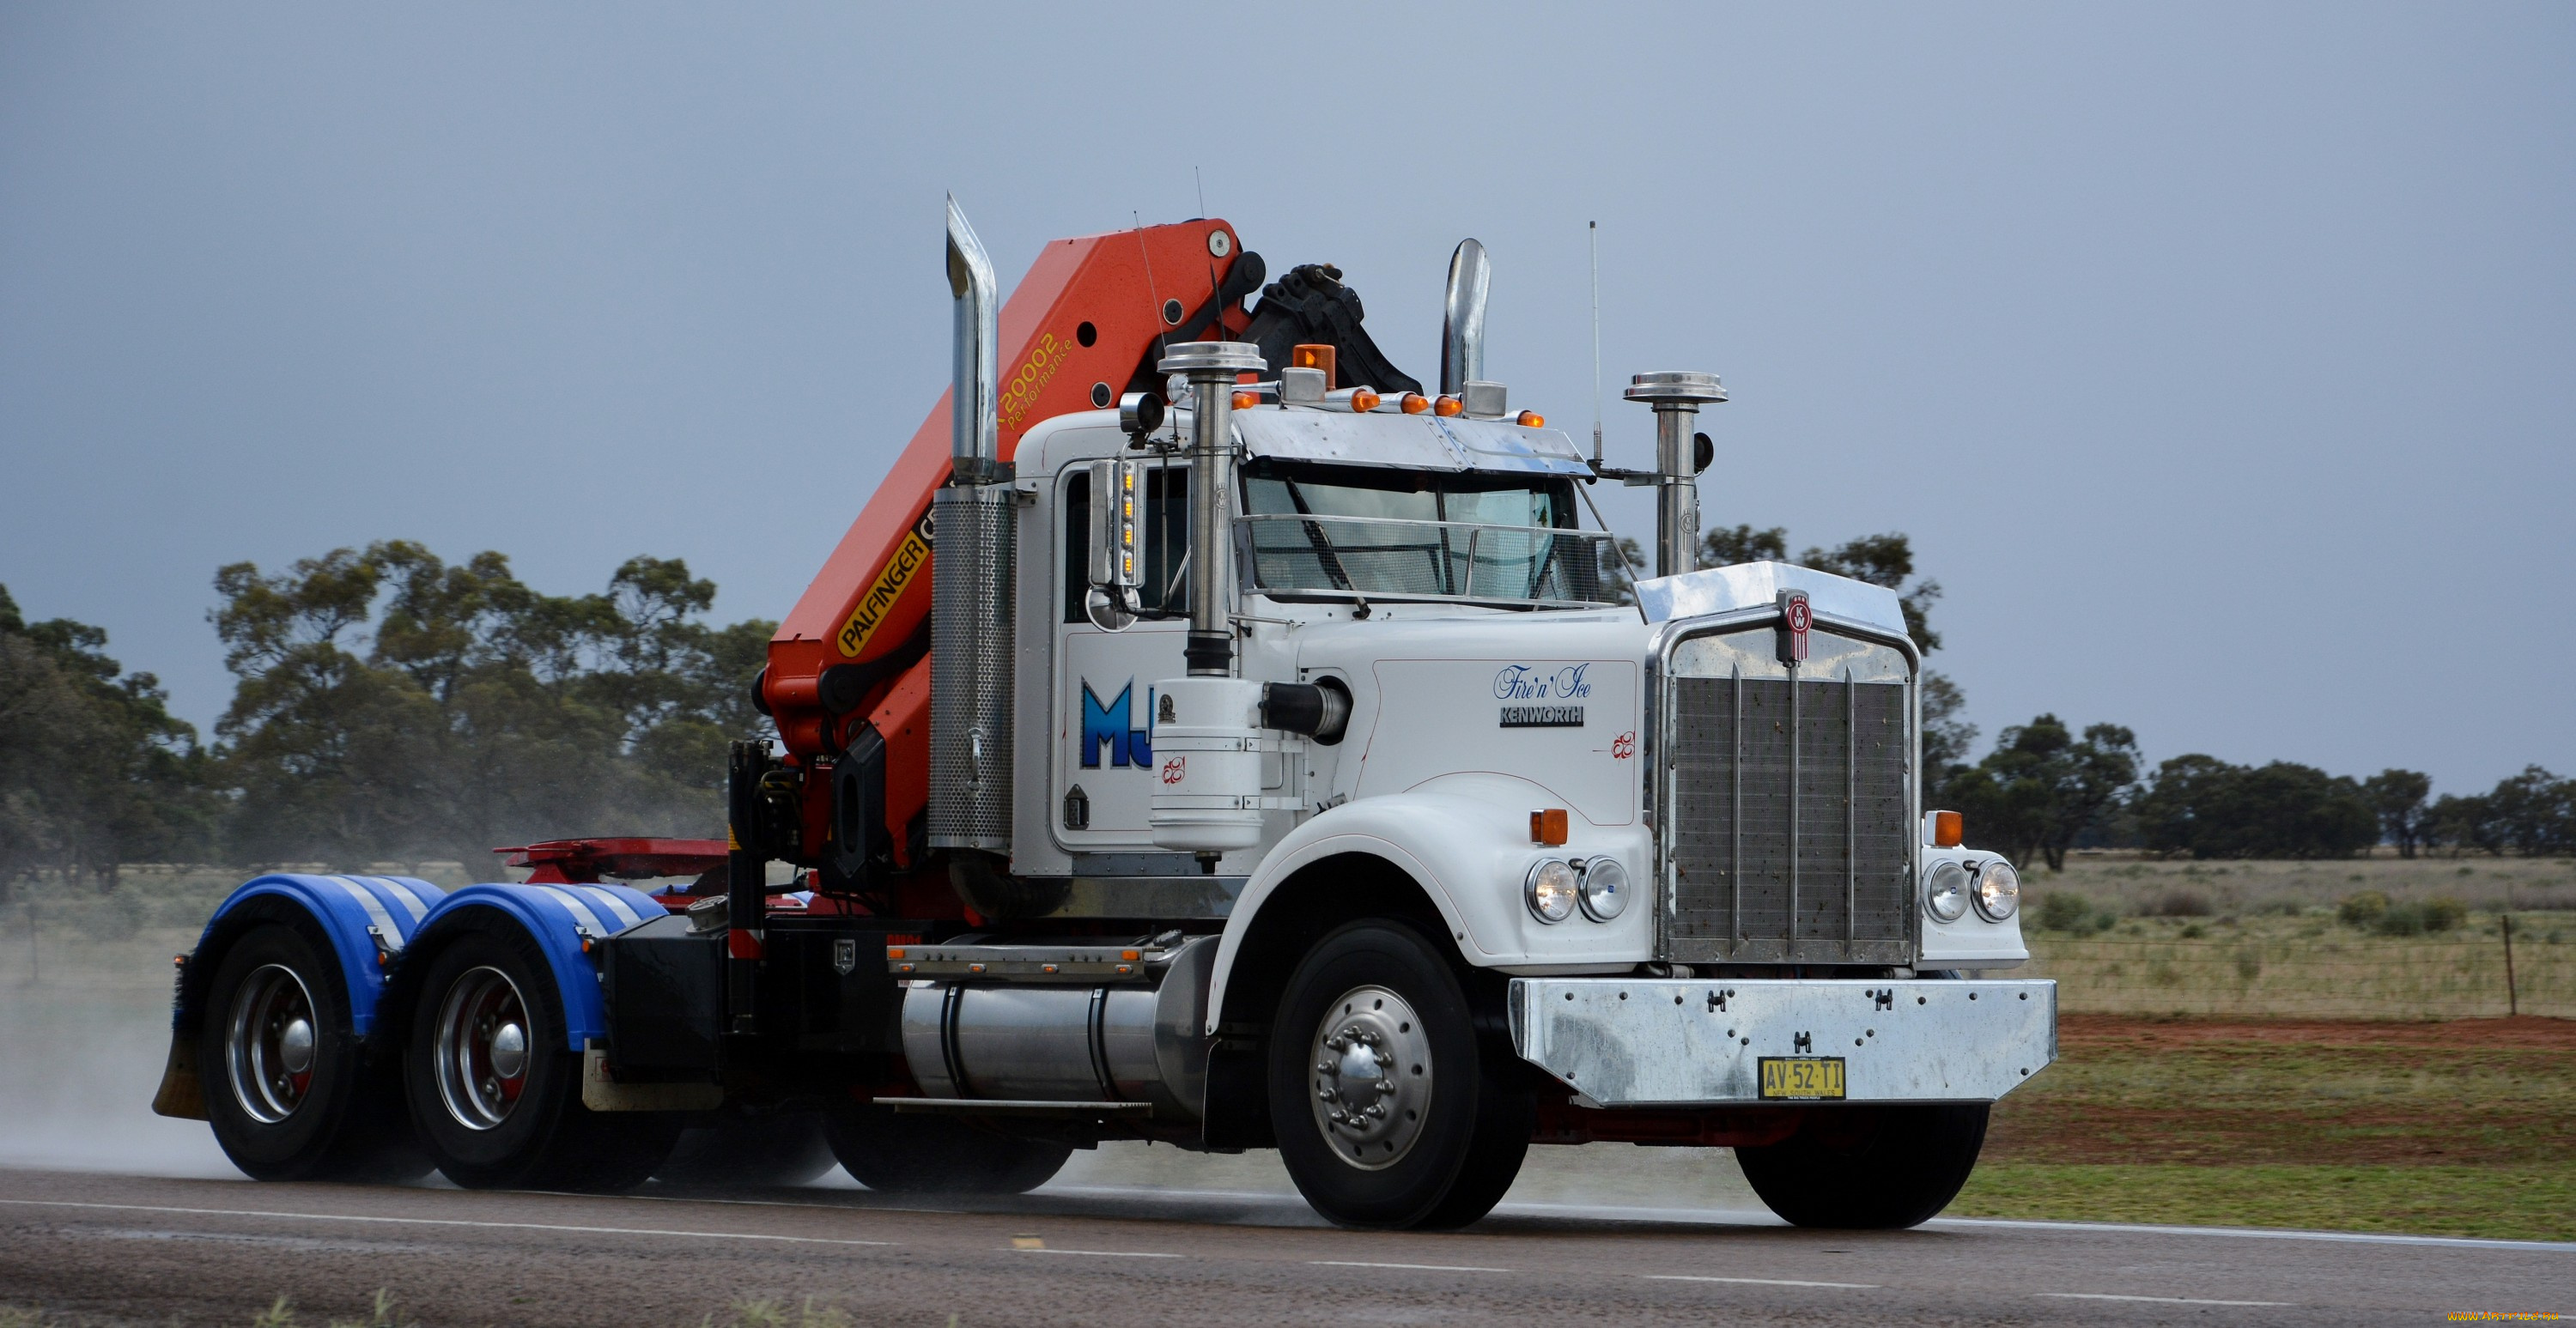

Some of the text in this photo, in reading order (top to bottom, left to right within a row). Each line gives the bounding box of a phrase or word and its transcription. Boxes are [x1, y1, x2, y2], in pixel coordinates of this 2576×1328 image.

[999, 332, 1059, 414] 20002
[1007, 338, 1072, 431] Performance
[841, 539, 925, 652] PALFINGER
[1500, 706, 1583, 725] KENWORTH
[1554, 663, 1591, 699] Ice
